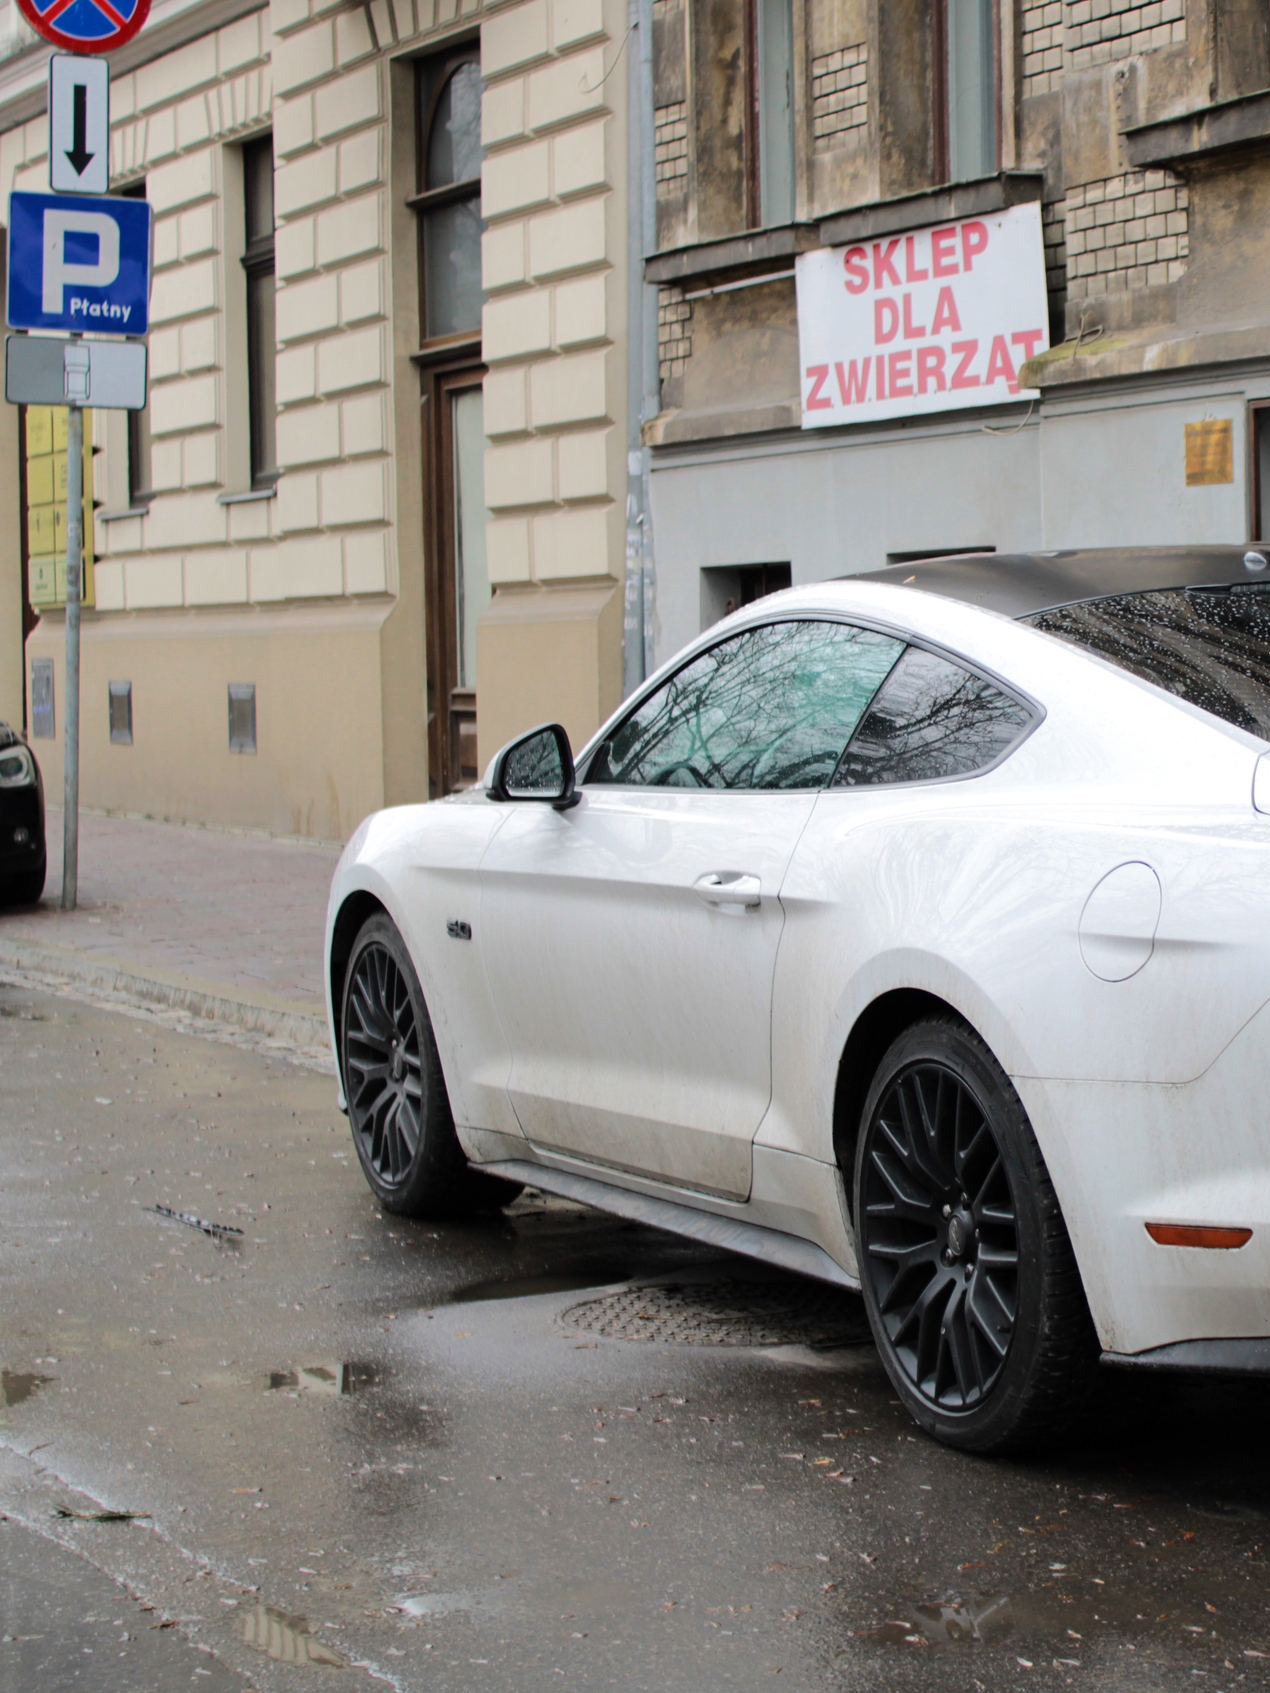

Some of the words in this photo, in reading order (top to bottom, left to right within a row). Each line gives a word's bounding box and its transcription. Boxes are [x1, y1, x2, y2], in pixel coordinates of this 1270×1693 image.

[42, 208, 120, 314] P
[843, 221, 989, 295] SKLEP
[70, 297, 131, 323] Płatny
[874, 285, 962, 345] DLA
[806, 328, 1043, 411] ZWIERZĄT
